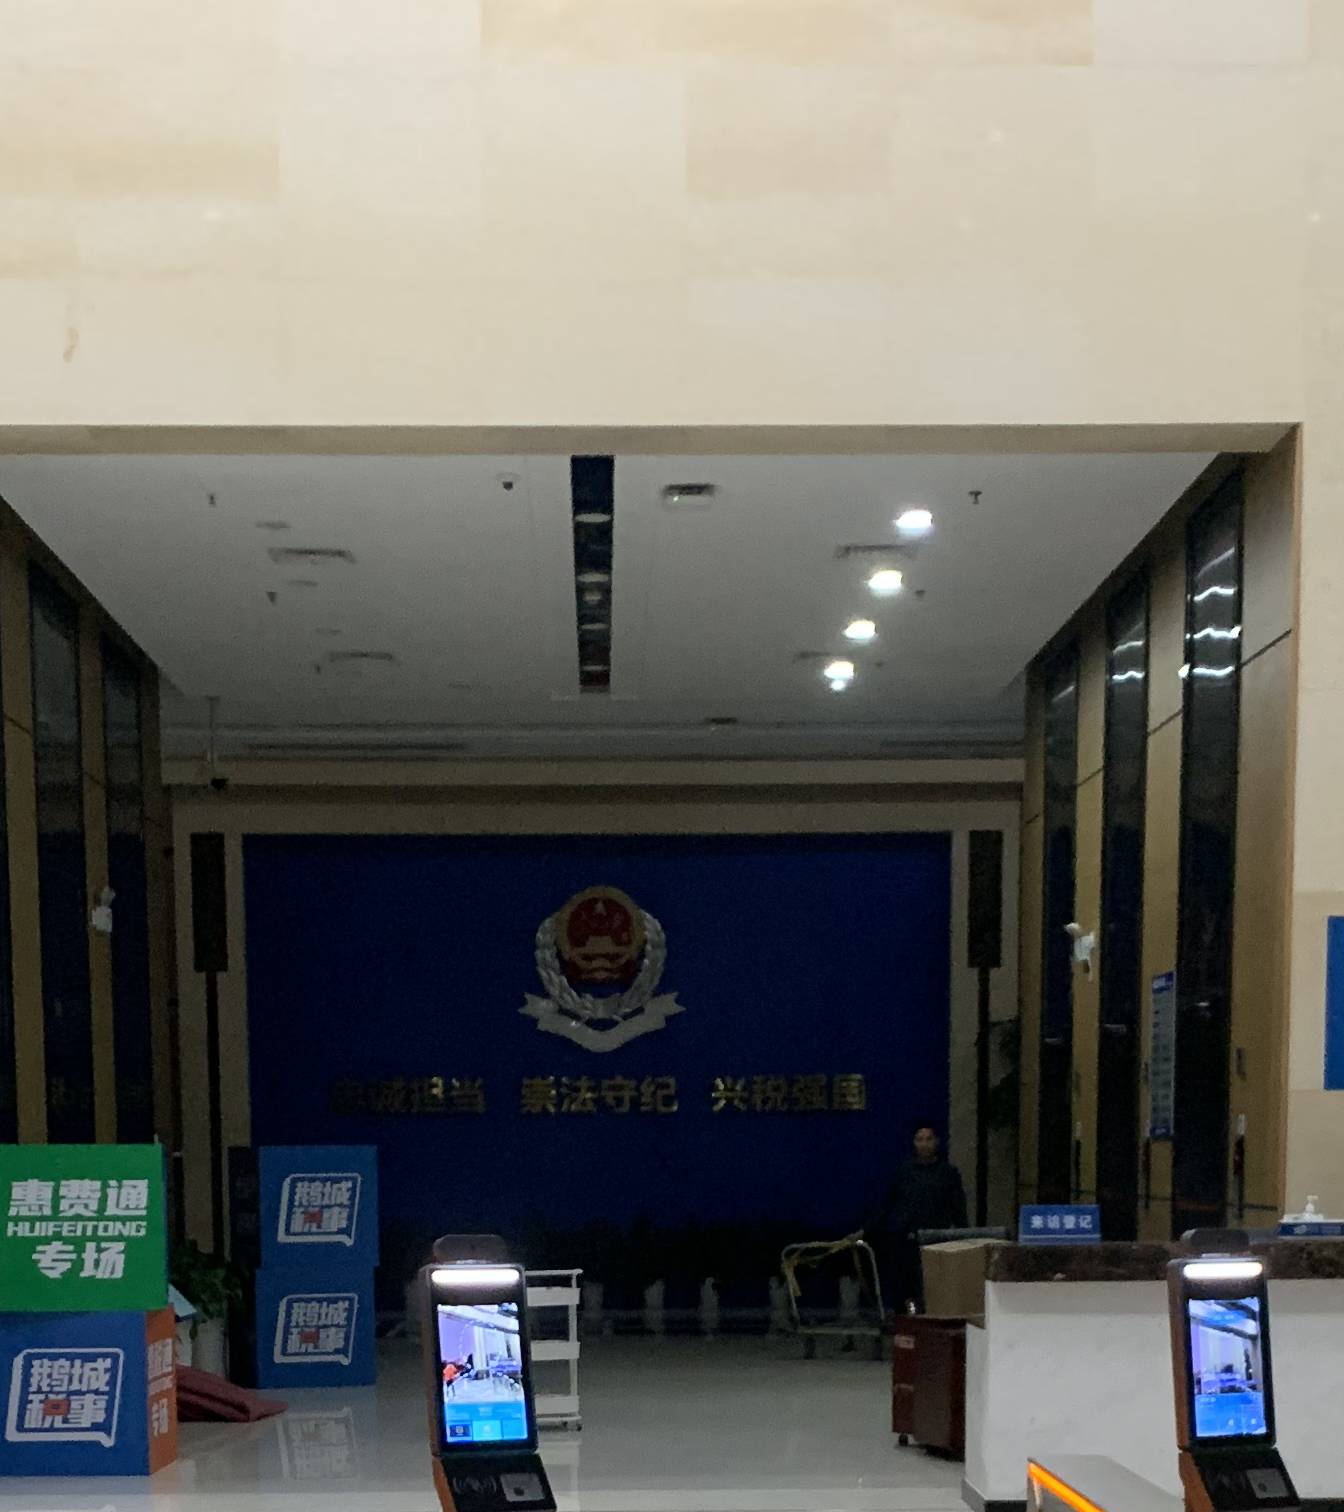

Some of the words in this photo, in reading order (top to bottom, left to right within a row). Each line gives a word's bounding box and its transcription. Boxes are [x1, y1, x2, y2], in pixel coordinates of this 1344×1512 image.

[520, 1074, 679, 1114] 崇法守纪
[8, 1179, 149, 1217] 惠费通
[294, 1180, 353, 1207] 鹅城
[7, 1221, 147, 1237] HUIFEITONG
[31, 1241, 127, 1280] 专场
[290, 1300, 348, 1327] 鹅城
[28, 1358, 112, 1393] 鹅城
